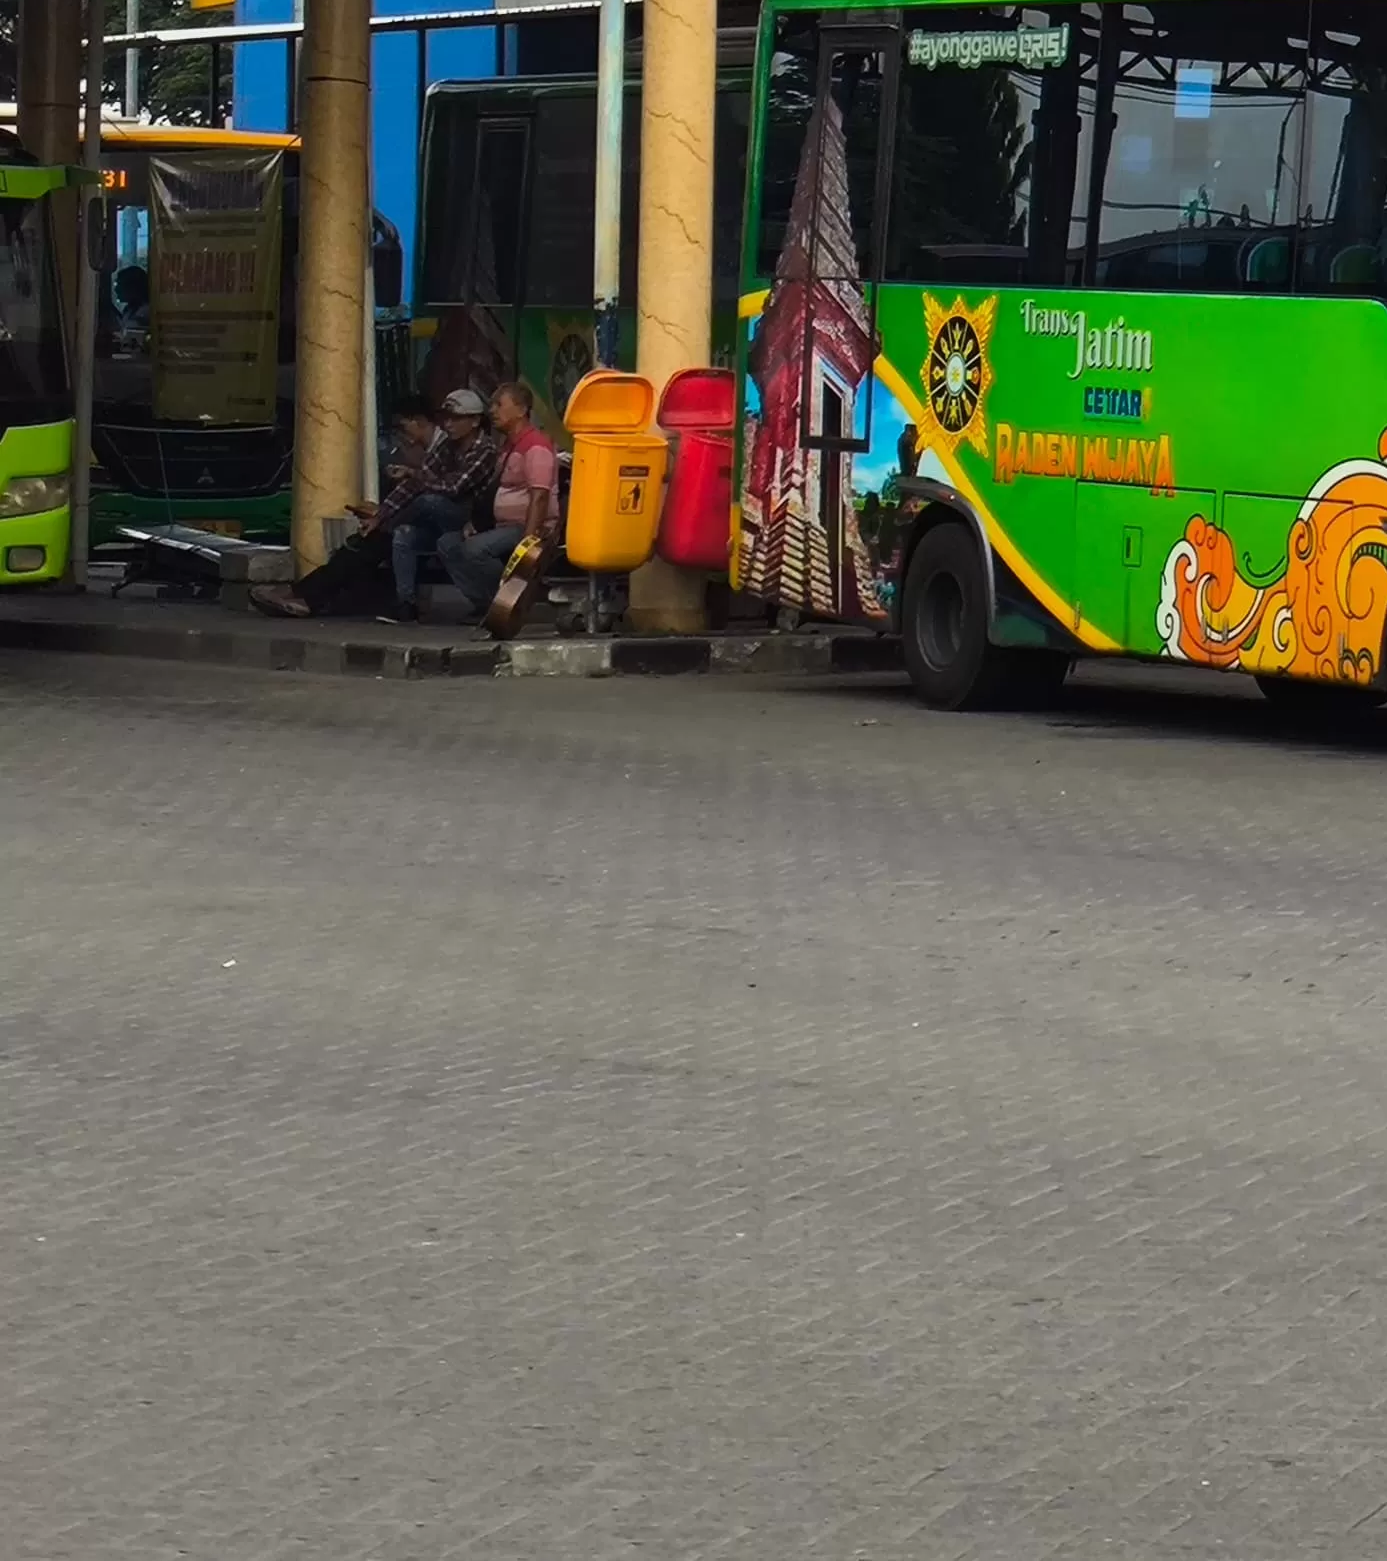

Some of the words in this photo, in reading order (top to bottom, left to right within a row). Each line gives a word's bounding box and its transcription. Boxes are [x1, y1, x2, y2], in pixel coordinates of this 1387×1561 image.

[1019, 298, 1070, 337] Trans
[1066, 310, 1153, 380] Jatim
[992, 422, 1077, 484] RADEN
[1081, 434, 1176, 498] WIJAYA
